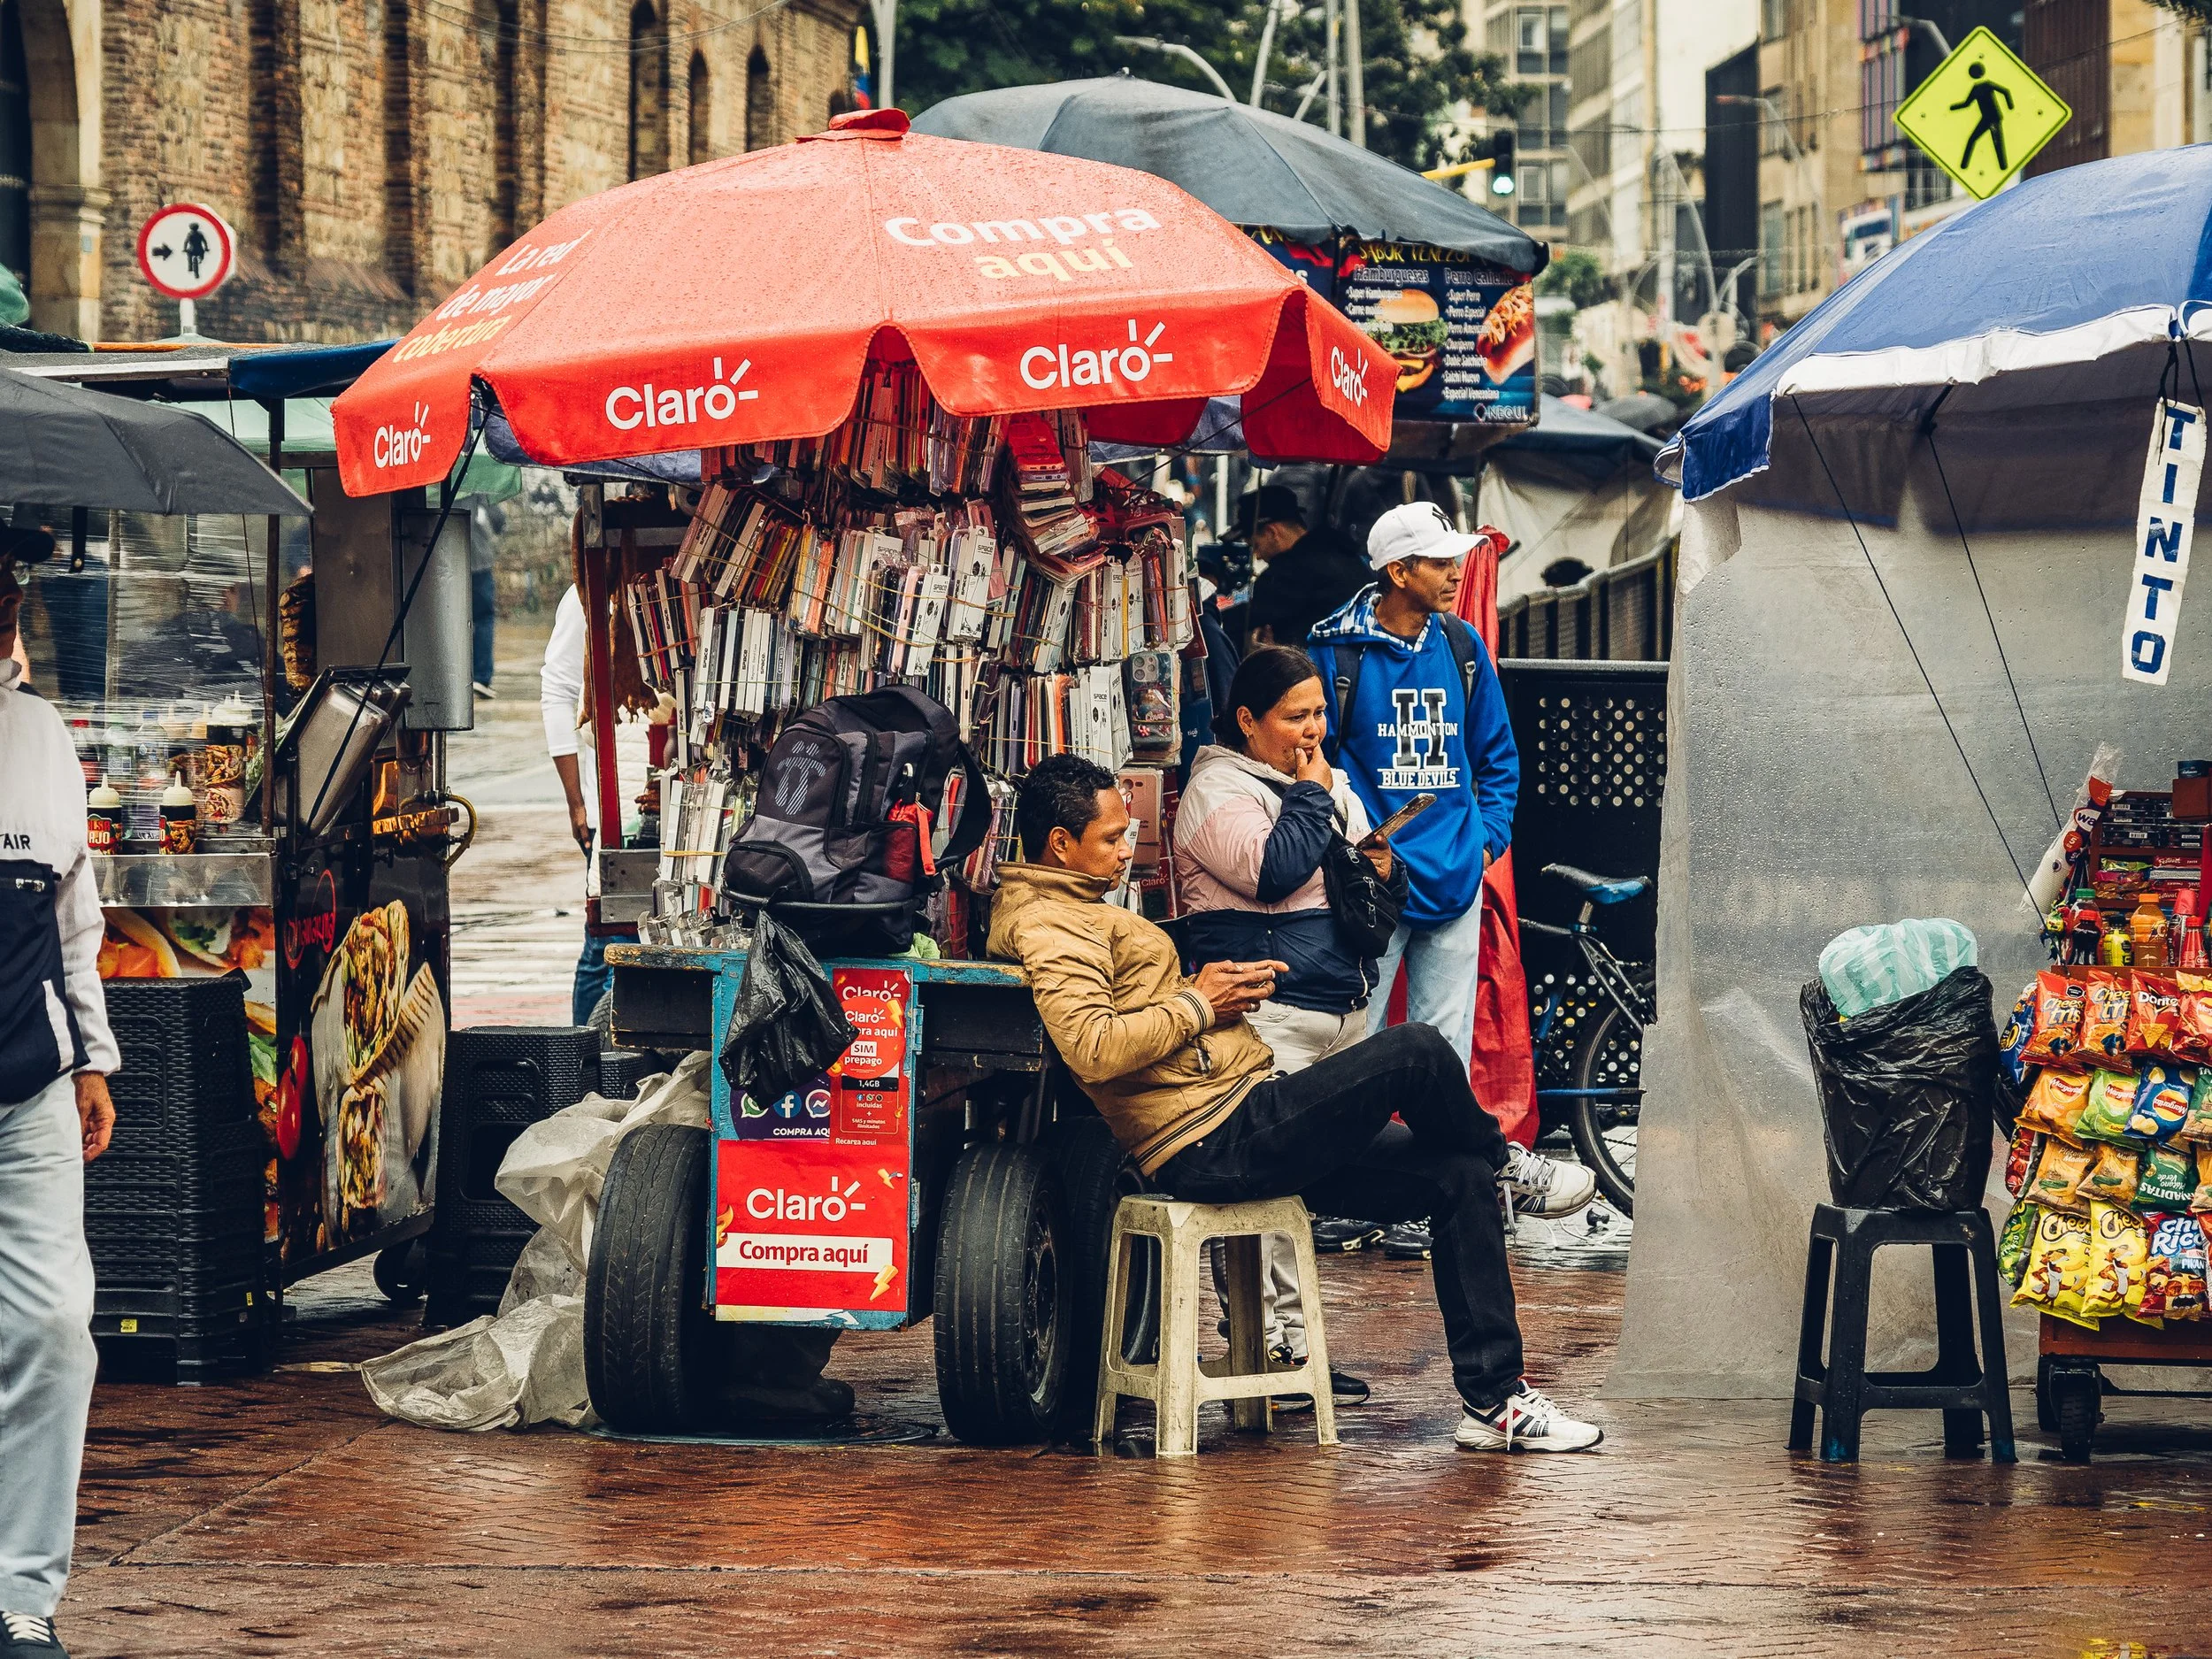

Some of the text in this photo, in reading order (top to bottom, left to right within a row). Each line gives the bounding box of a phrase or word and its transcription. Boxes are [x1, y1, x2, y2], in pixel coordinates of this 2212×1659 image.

[885, 209, 1162, 246] Compra
[495, 229, 593, 276] La red
[1353, 265, 1430, 287] Hamburguesas
[1444, 267, 1473, 285] Perro
[436, 273, 557, 320] de mayor
[392, 315, 512, 363] cobertura
[1020, 343, 1151, 390] Claro
[1331, 346, 1363, 407] Claro
[605, 380, 736, 431] Claro
[374, 425, 422, 468] Claro
[2131, 407, 2196, 675] TINTO
[1378, 722, 1458, 737] HAMMONTON
[1382, 770, 1456, 786] BLUE DEVILS
[88, 832, 111, 844] AJO
[845, 1010, 880, 1024] Claro
[854, 1044, 874, 1053] SIM
[874, 1027, 898, 1039] aquí
[844, 1056, 882, 1067] prepago
[747, 1187, 847, 1222] Claro
[740, 1240, 869, 1267] Compra aquí
